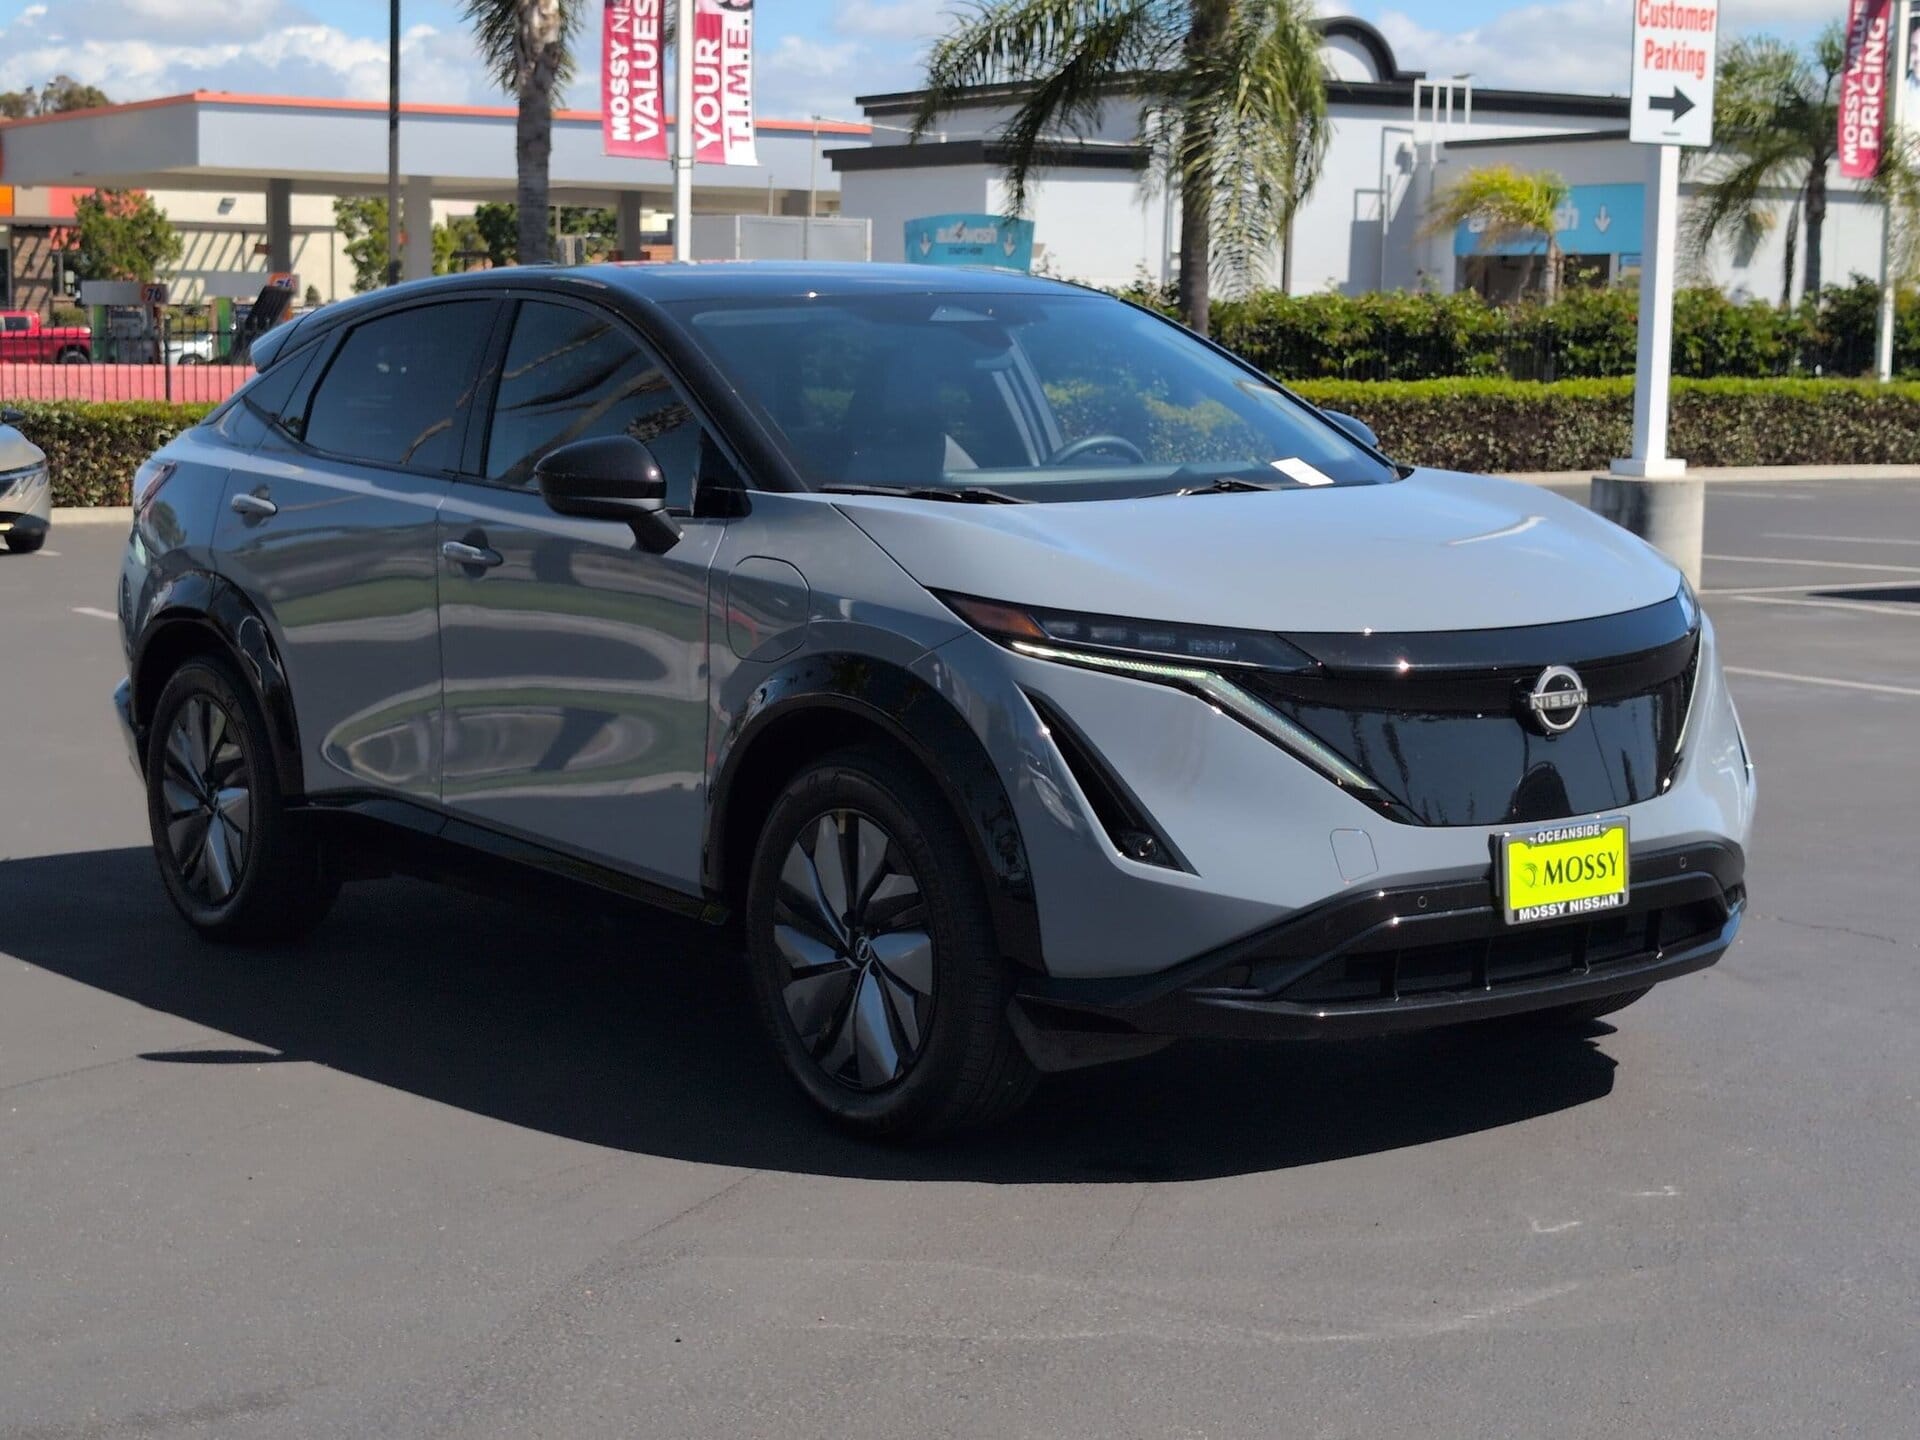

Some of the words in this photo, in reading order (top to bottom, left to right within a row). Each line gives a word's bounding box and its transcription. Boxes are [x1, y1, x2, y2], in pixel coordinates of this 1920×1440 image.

[1638, 0, 1715, 32] Customer
[633, 0, 660, 143] VALUES
[1643, 38, 1706, 80] Parking
[610, 40, 631, 142] MOSSY
[694, 38, 722, 150] YOUR
[1859, 17, 1887, 150] PRICING
[1843, 81, 1861, 166] MOSSY
[1530, 688, 1588, 710] NISSAN
[1537, 824, 1600, 844] OCEANSIDE
[1543, 851, 1620, 886] MOSSY
[1519, 902, 1566, 921] MOSSY
[1569, 893, 1619, 912] NISSAN
